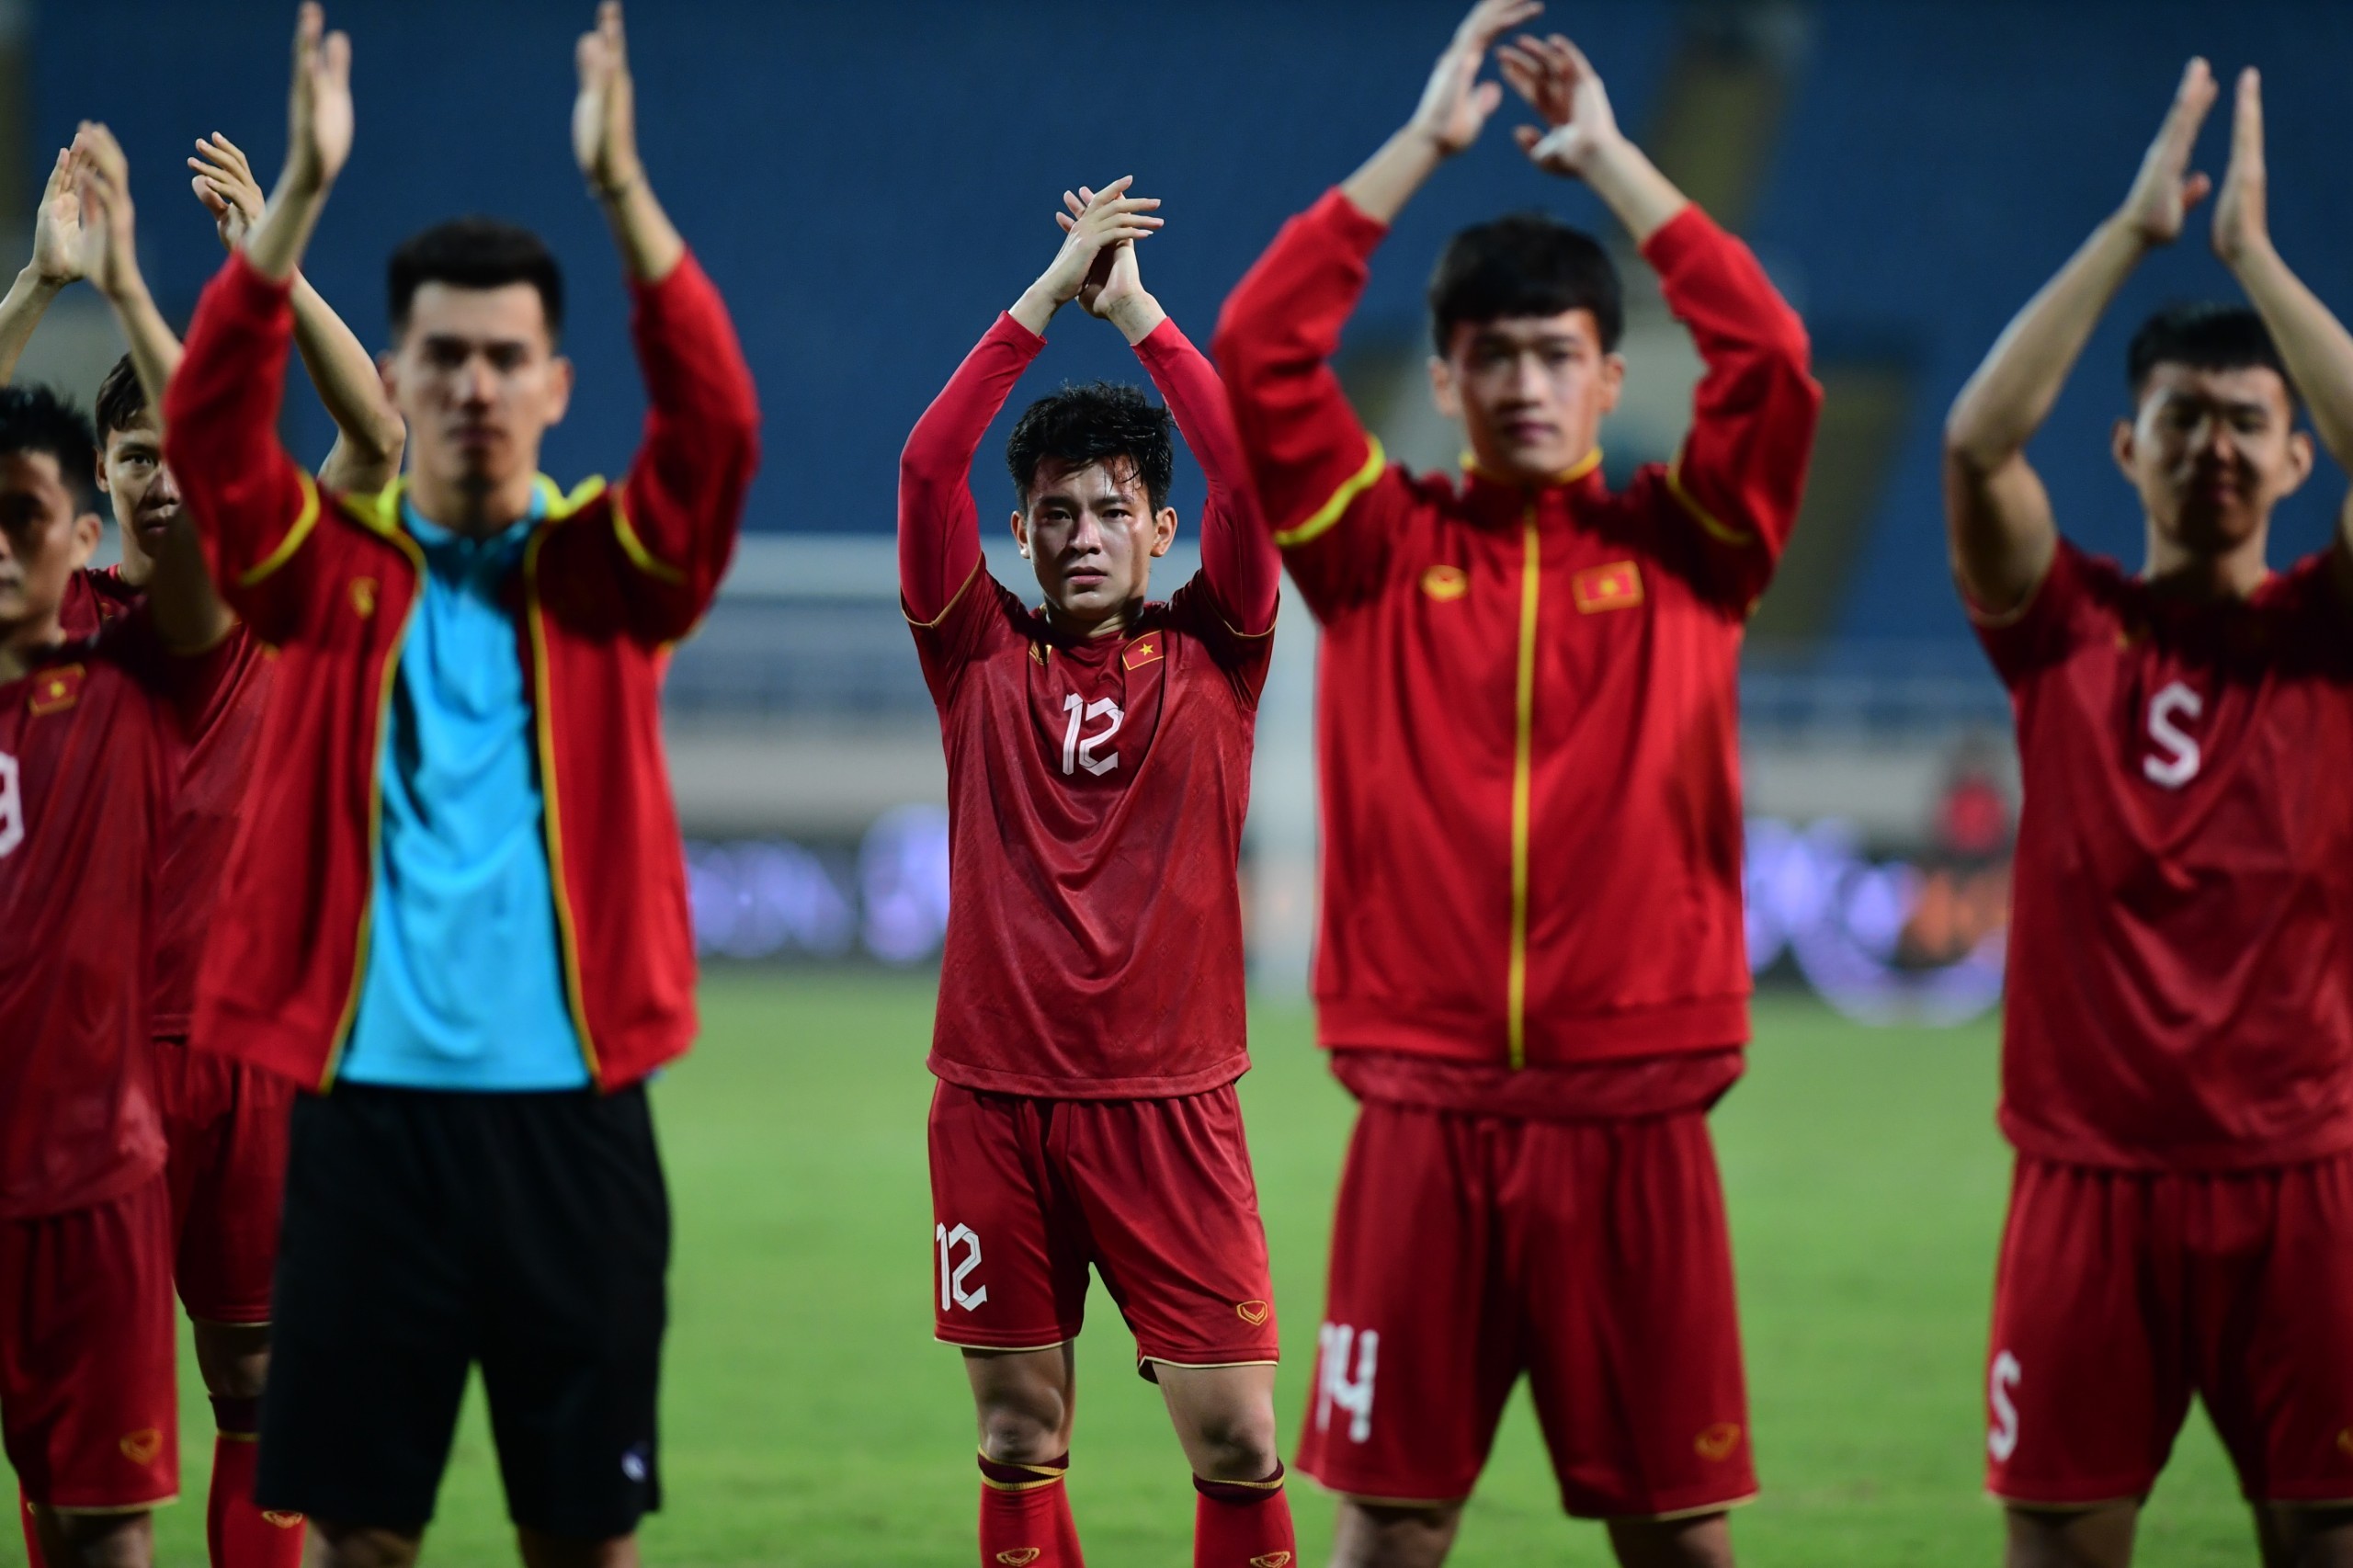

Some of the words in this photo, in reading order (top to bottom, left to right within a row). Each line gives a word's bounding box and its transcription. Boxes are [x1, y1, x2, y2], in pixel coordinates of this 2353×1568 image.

[1063, 693, 1125, 777] 12
[936, 1221, 988, 1312] 12
[1315, 1322, 1380, 1444] 14
